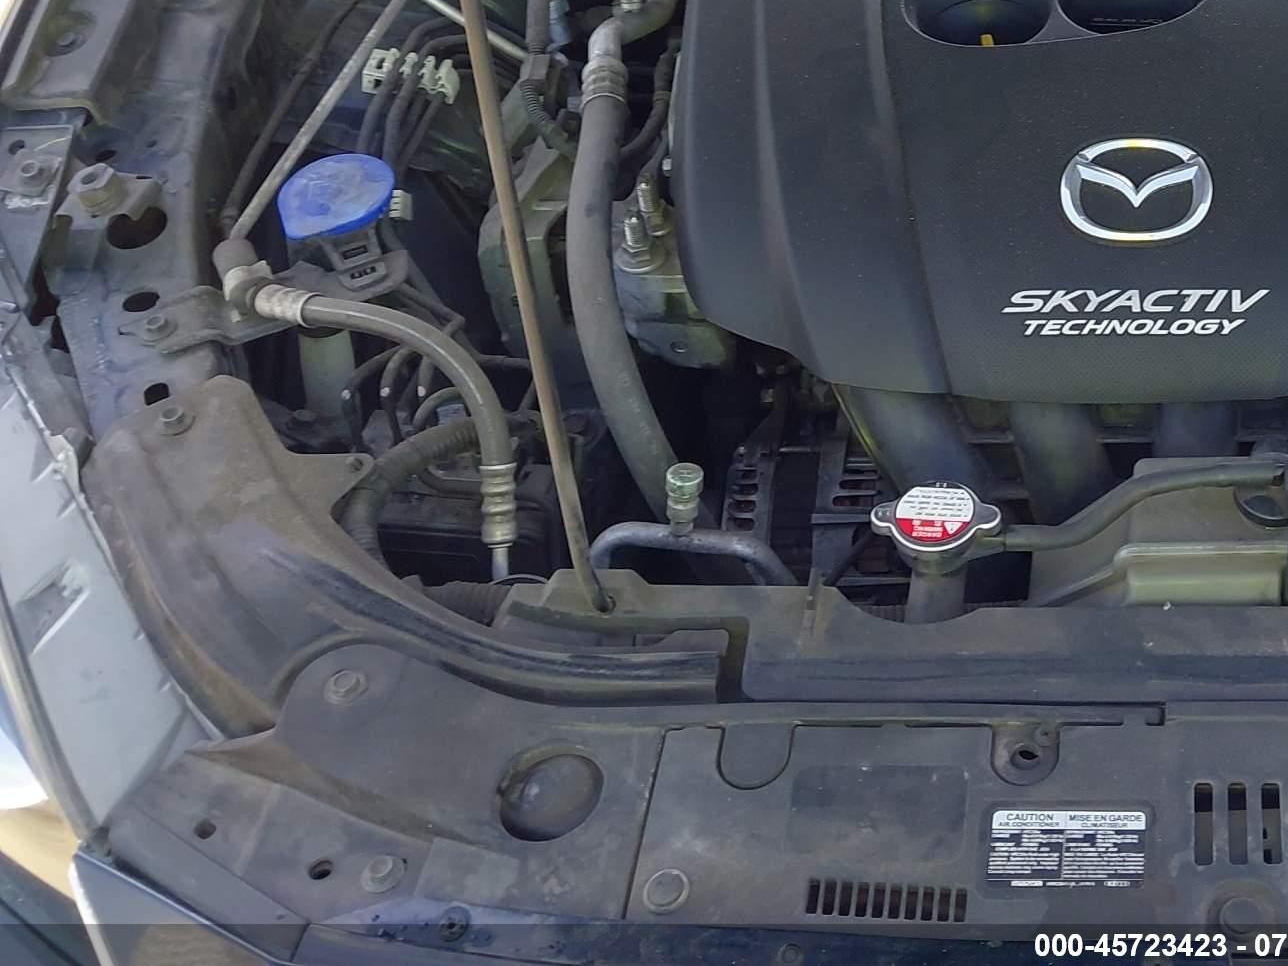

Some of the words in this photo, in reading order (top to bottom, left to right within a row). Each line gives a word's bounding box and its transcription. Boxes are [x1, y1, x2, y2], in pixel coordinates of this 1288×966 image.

[1001, 289, 1270, 314] SKYACTIV
[1023, 319, 1246, 336] TECHNOLOGY
[1006, 812, 1054, 822] CAUTION
[1069, 814, 1093, 822] MISE
[1094, 814, 1108, 822] EN
[1109, 814, 1143, 822] GARDE
